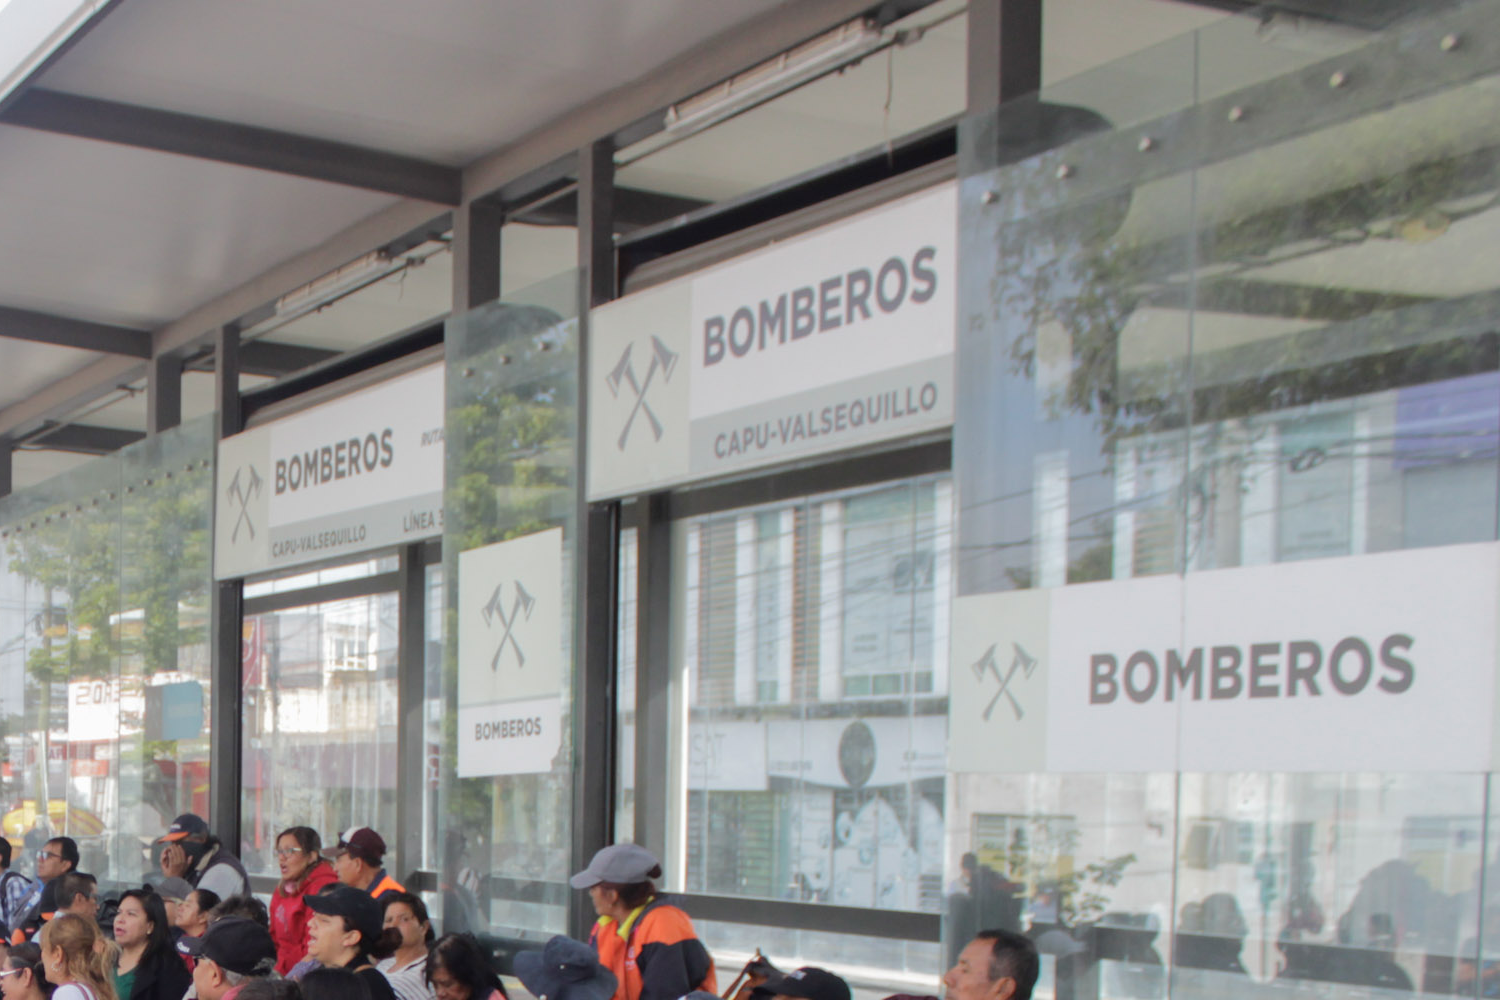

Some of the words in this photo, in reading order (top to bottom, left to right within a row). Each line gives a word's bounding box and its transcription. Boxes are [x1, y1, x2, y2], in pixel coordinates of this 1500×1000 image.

[703, 246, 938, 368] BOMBEROS
[714, 381, 938, 459] CAPU-VALSEQUILLO
[275, 428, 393, 496] BOMBEROS
[272, 524, 366, 557] CAPU-VALSEQUILLO
[1088, 633, 1417, 705] BOMBEROS
[474, 717, 542, 740] BOMBEROS
